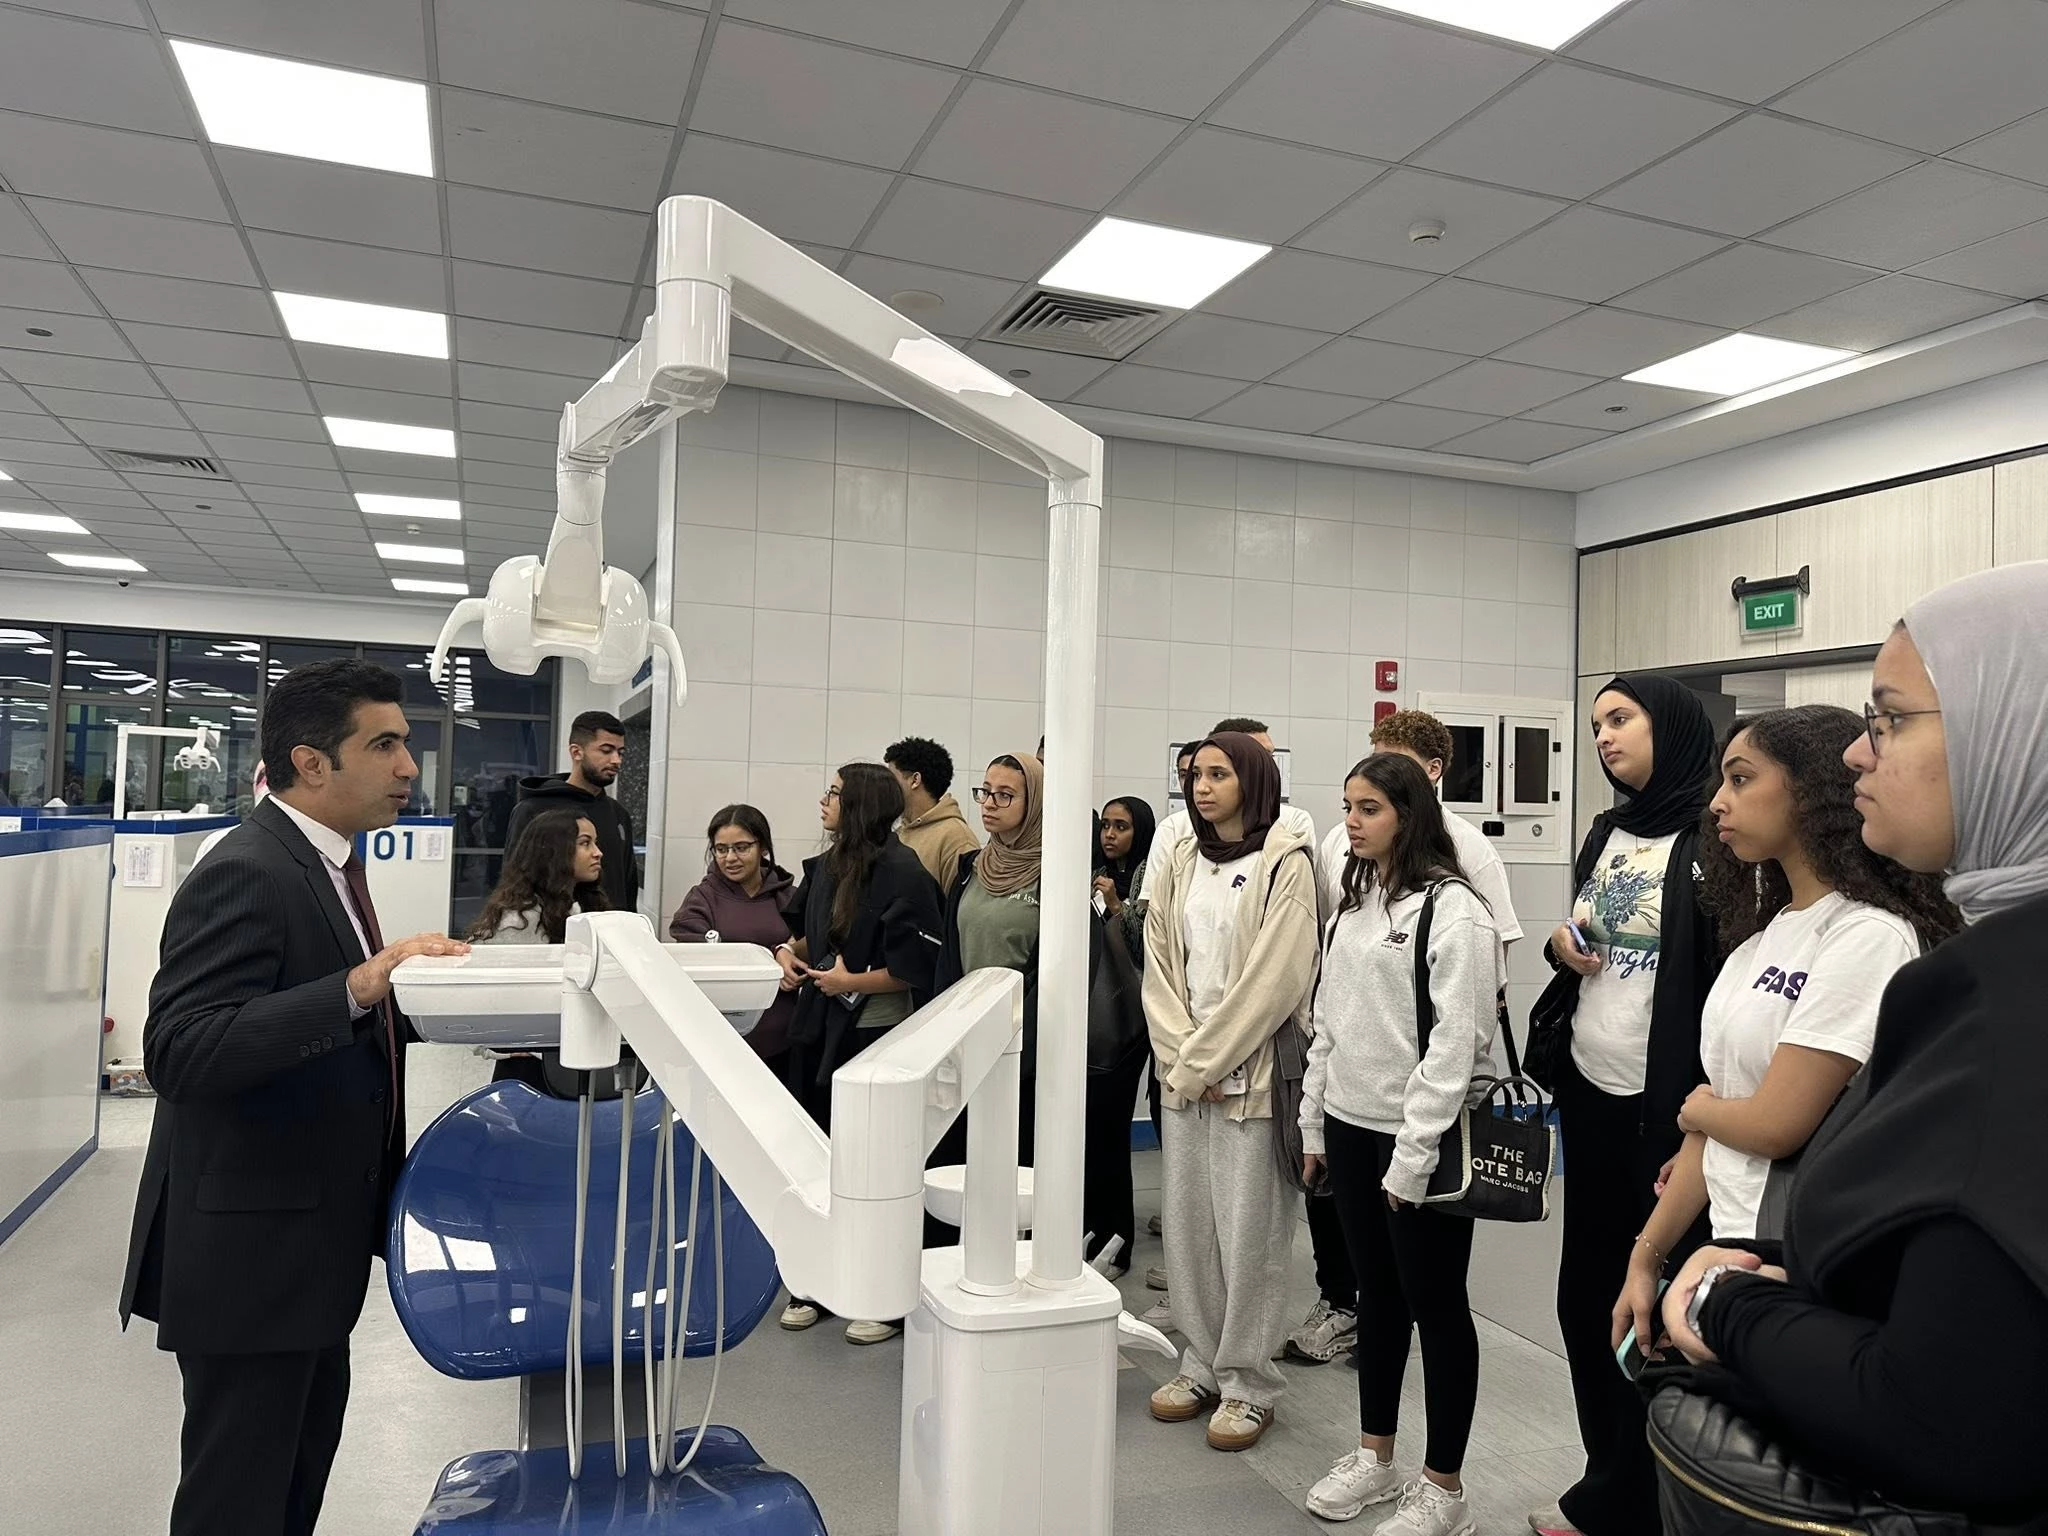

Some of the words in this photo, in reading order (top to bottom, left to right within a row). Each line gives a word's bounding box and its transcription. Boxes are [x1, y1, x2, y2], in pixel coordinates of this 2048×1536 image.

[1754, 603, 1785, 620] EXIT
[374, 830, 413, 860] 01
[1231, 874, 1247, 889] F
[1752, 966, 1808, 1001] FAS
[1490, 1144, 1525, 1164] THE
[1480, 1174, 1501, 1186] MARC
[1502, 1181, 1529, 1193] JACOBS
[1515, 1167, 1543, 1185] BAG
